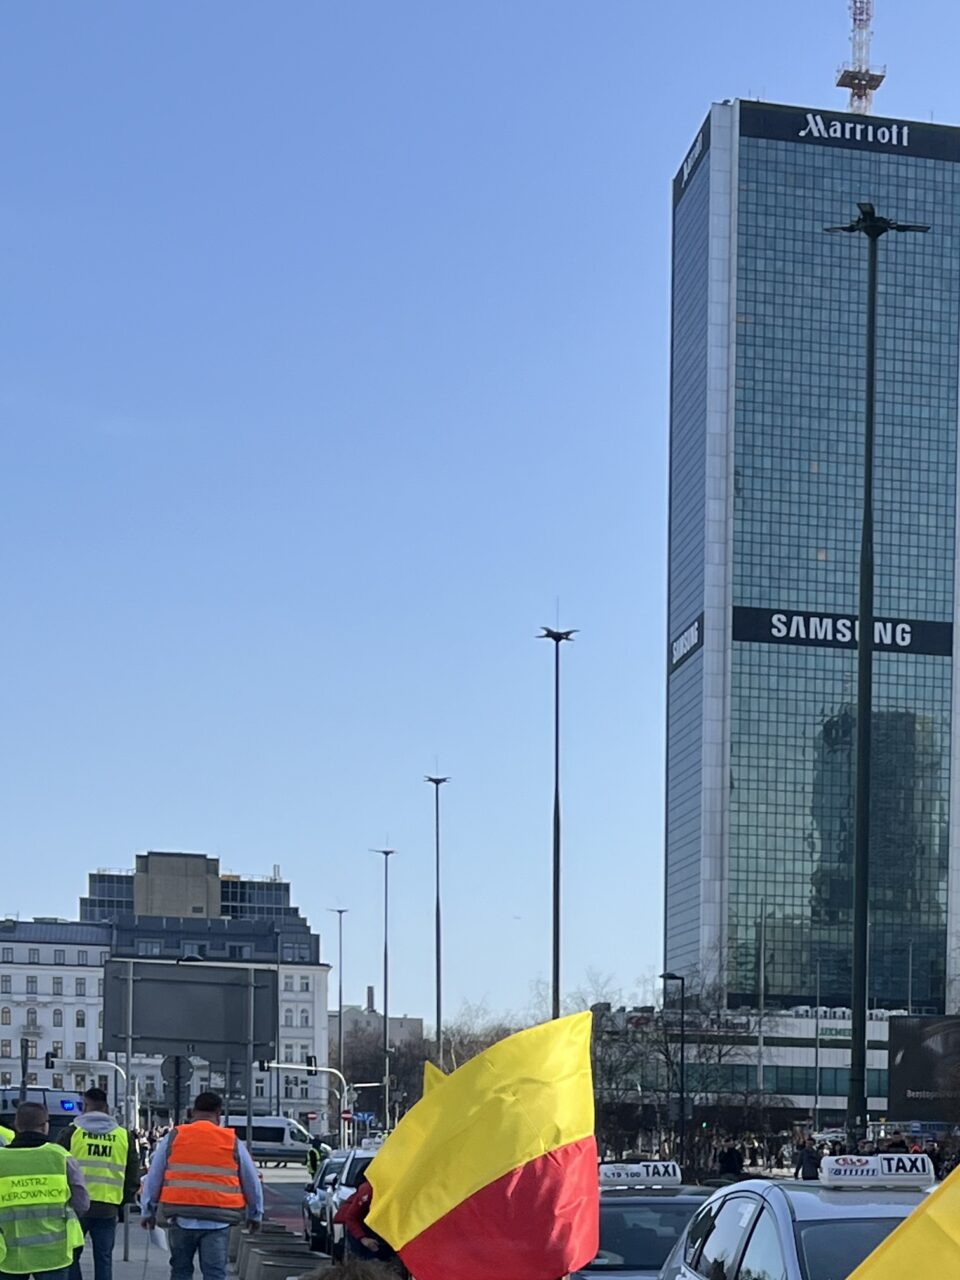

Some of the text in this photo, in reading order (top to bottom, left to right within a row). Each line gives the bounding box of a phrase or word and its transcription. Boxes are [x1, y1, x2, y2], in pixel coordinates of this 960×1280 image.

[798, 113, 910, 147] Marriott
[87, 1143, 112, 1157] TAXI
[642, 1164, 677, 1177] TAXI
[883, 1157, 926, 1173] TAXI
[11, 1177, 48, 1188] MISTRZ
